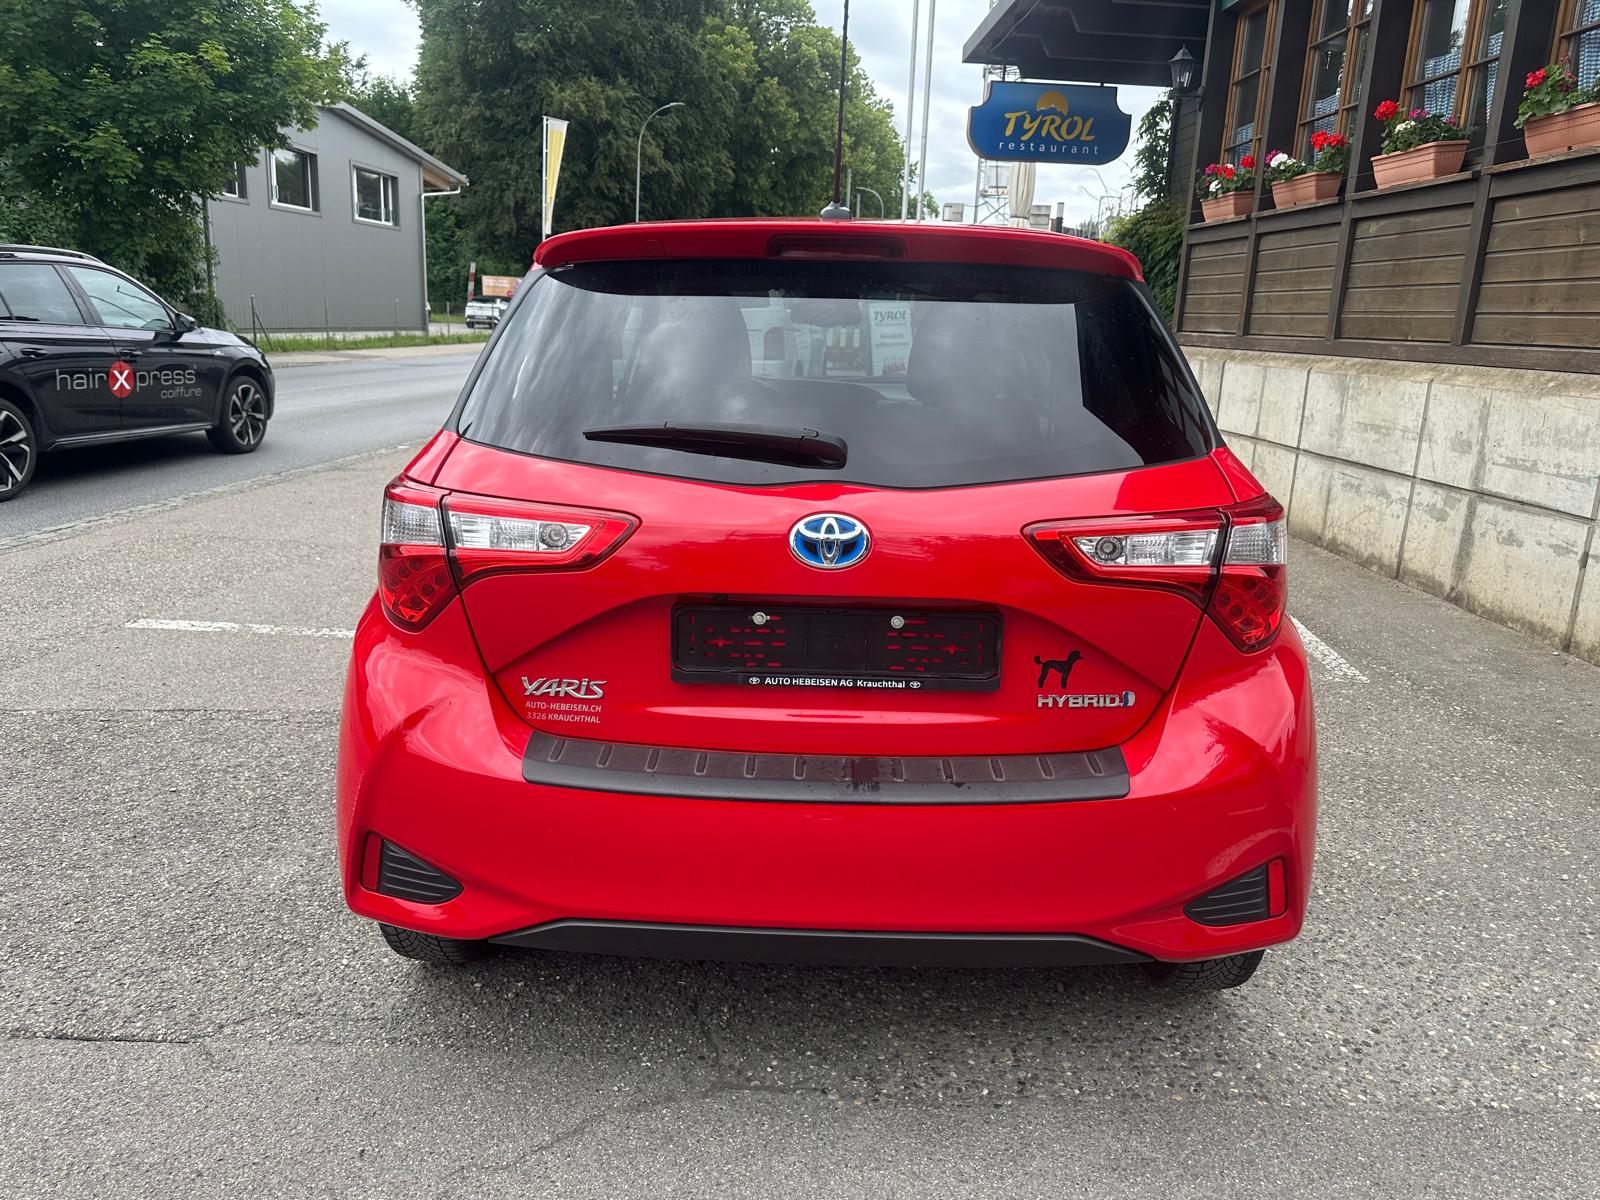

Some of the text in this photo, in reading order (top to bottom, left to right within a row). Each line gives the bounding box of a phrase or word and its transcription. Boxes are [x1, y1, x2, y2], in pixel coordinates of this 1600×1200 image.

[1004, 110, 1096, 142] TYROL
[999, 141, 1099, 155] restaurant
[873, 310, 908, 322] TYROL
[160, 386, 202, 399] coiffure
[764, 677, 906, 688] AUTO HEBEISEN AG Krauchthal
[525, 701, 602, 712] AUTO-HEBEISEN.CH
[1037, 694, 1119, 708] HYBRID
[527, 711, 601, 724] 3326 KRAUCHTHAL
